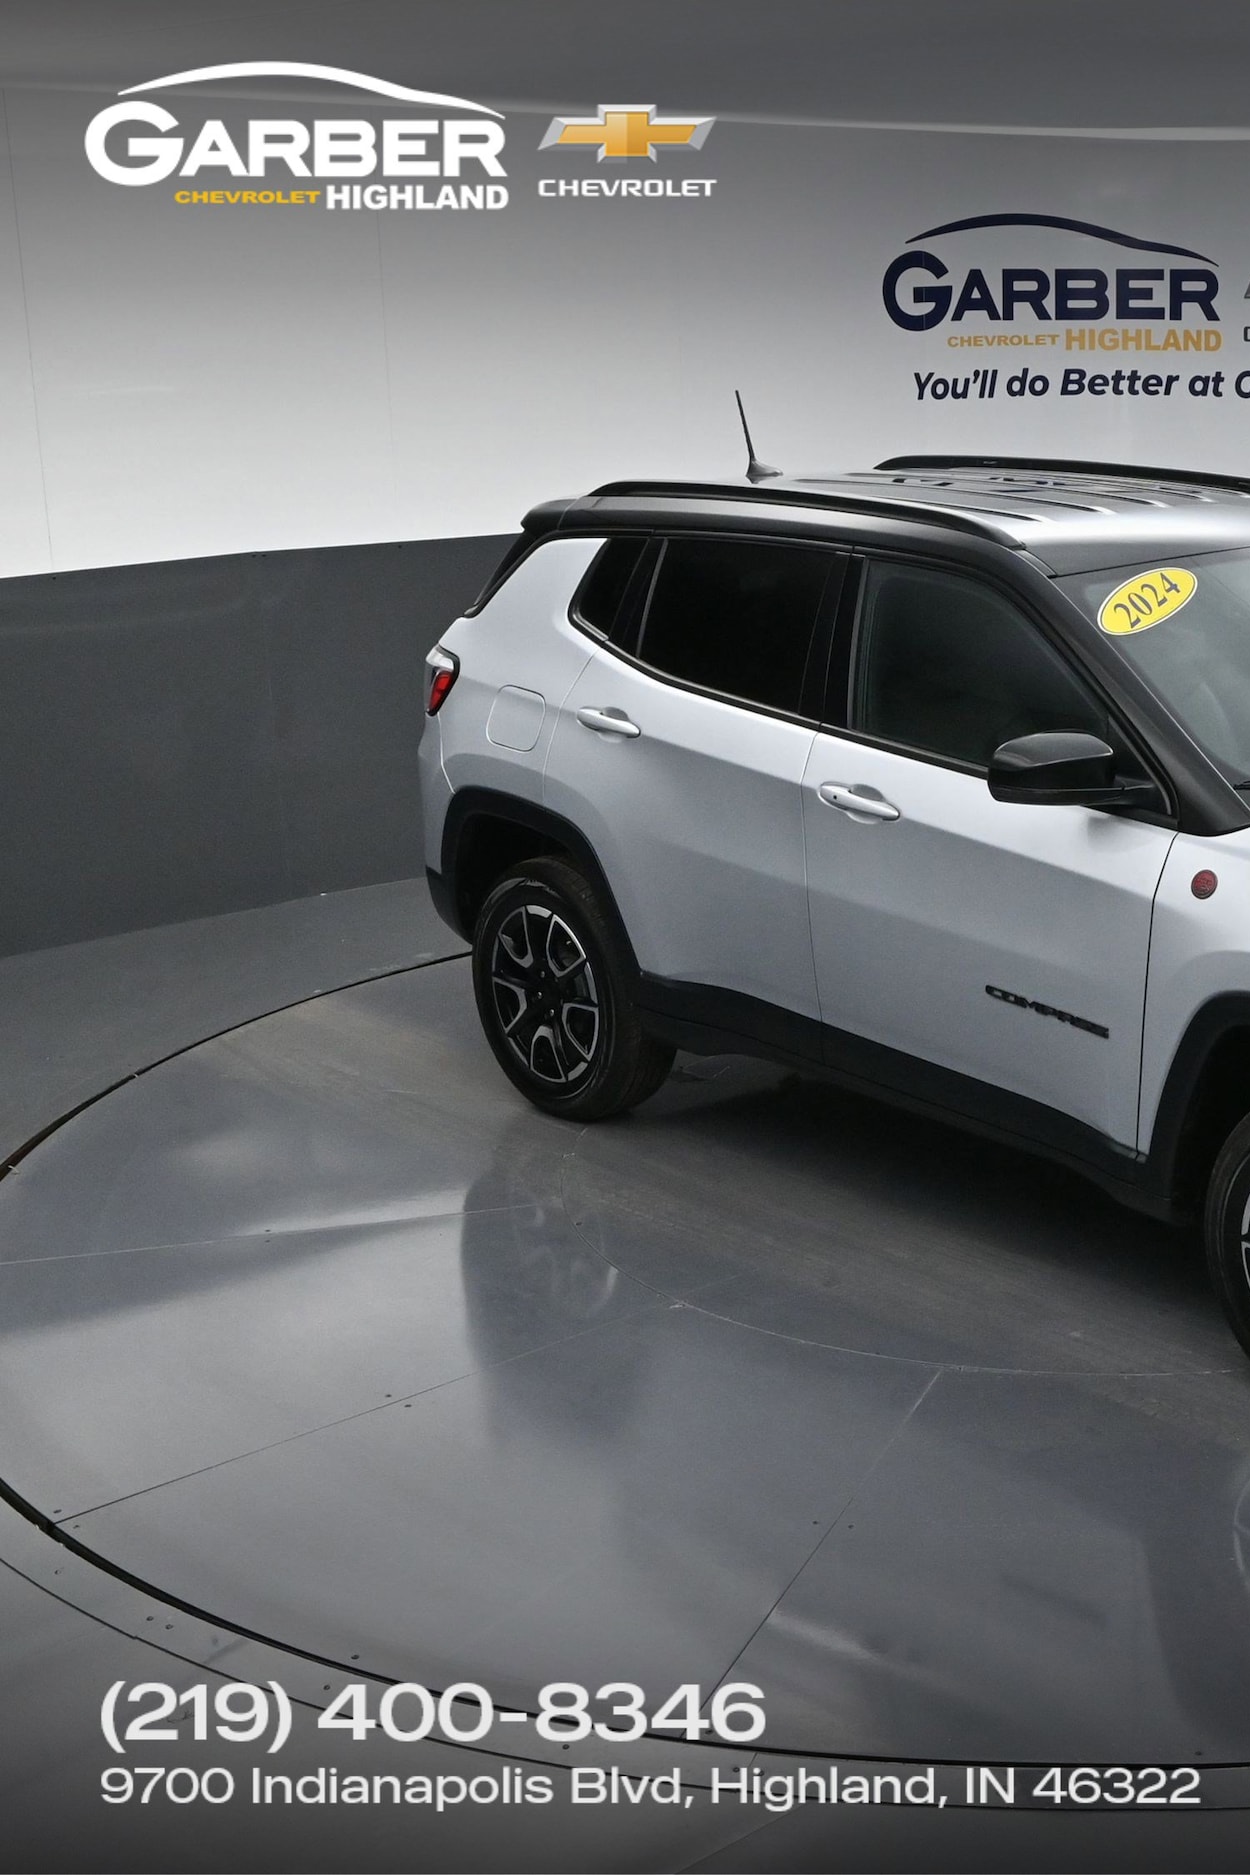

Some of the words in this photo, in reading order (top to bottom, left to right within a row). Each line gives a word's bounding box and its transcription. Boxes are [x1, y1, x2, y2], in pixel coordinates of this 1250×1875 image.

[882, 250, 1220, 332] GARBER
[947, 333, 1060, 348] CHEVROLET
[1065, 328, 1223, 352] HIGHLAND
[1006, 367, 1050, 397] do
[1060, 368, 1180, 396] Better
[1188, 371, 1225, 398] at
[1113, 572, 1182, 629] 2024
